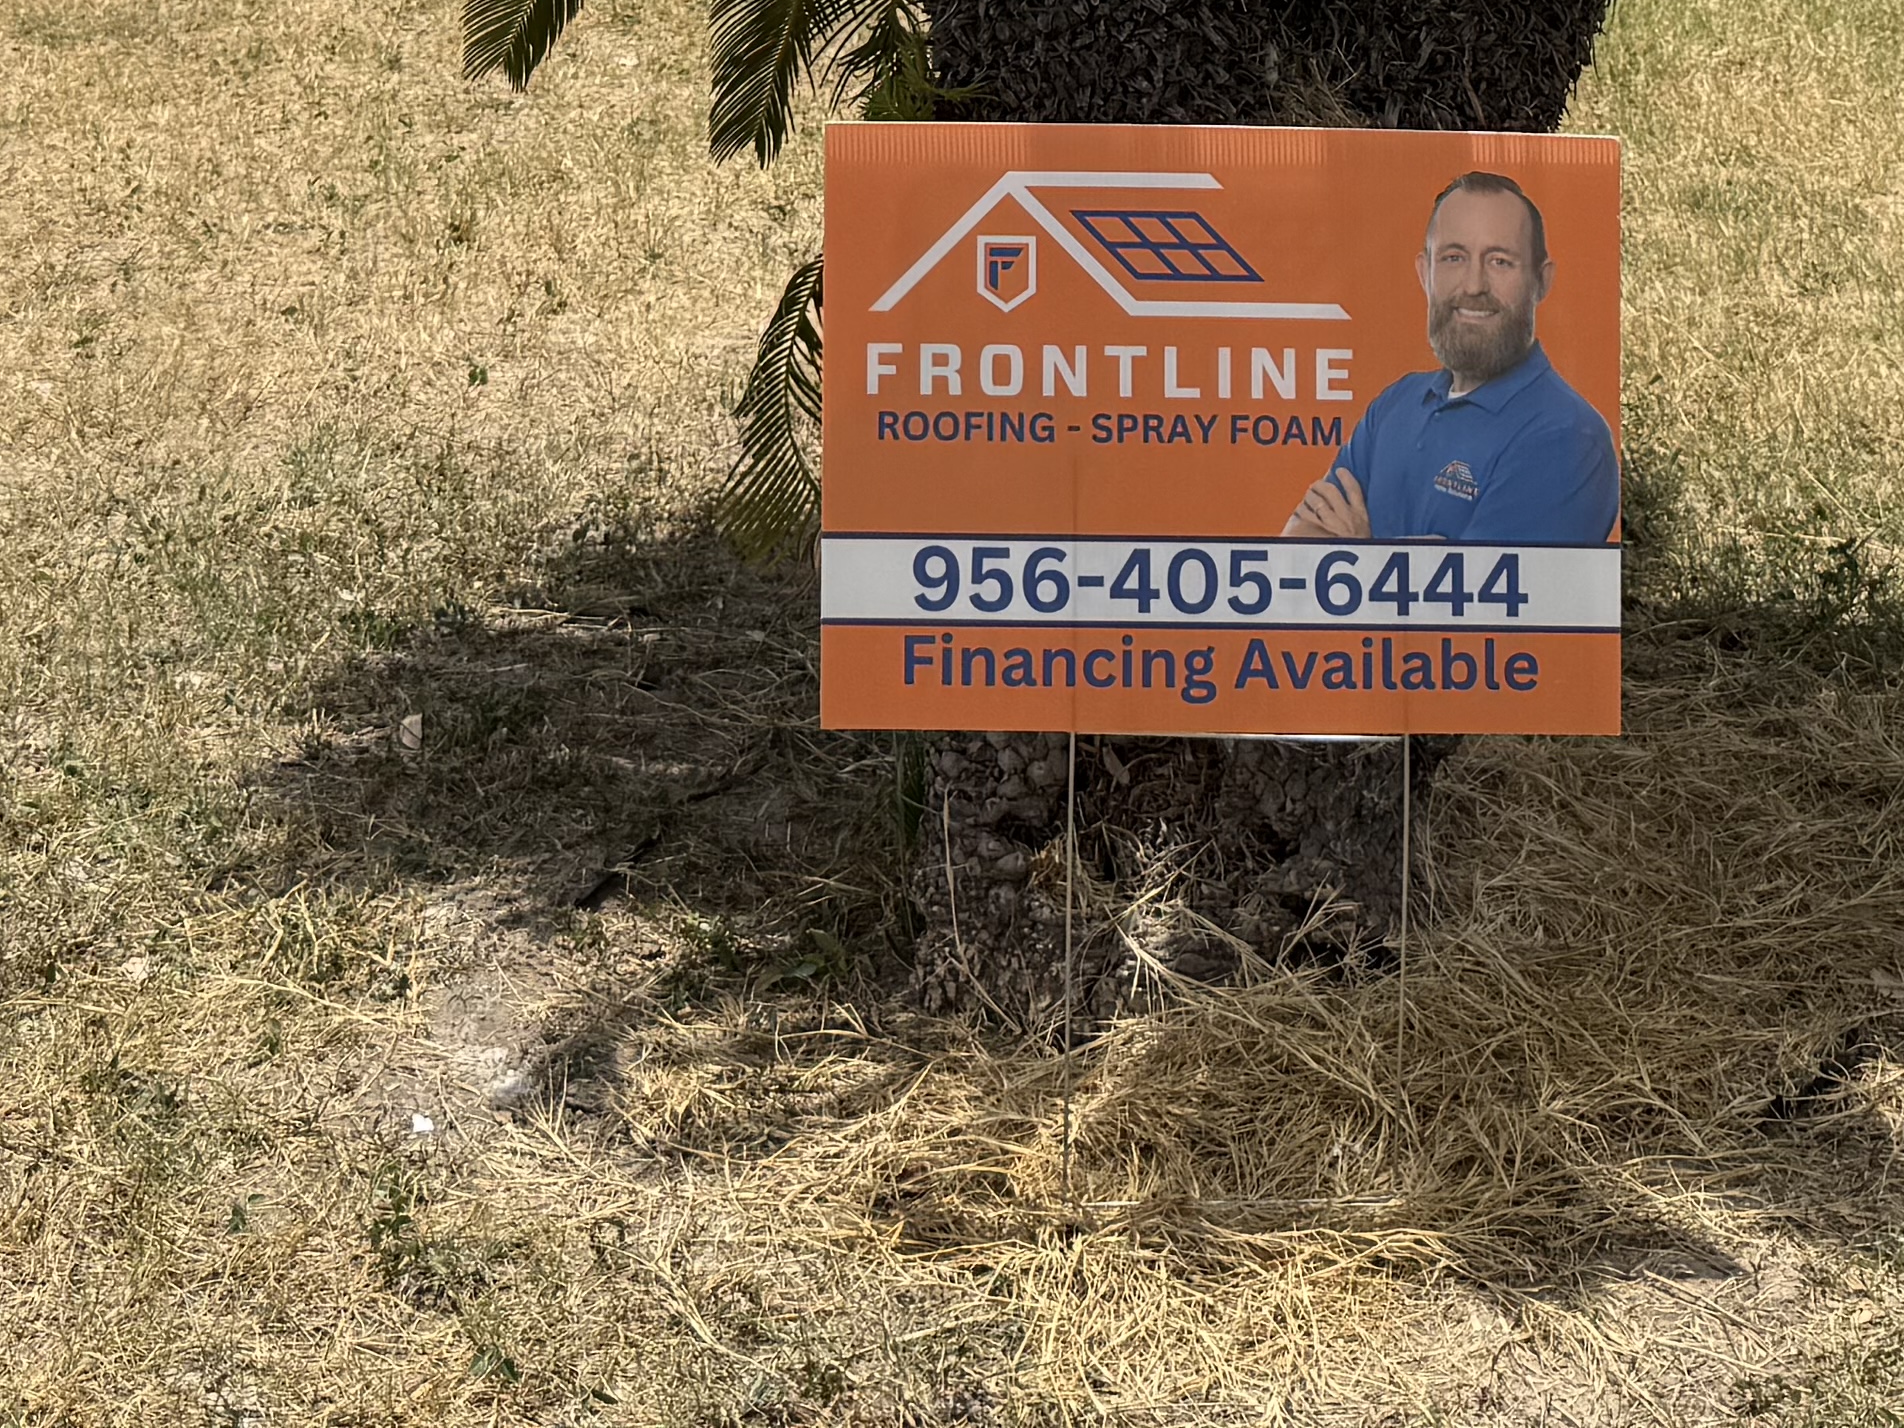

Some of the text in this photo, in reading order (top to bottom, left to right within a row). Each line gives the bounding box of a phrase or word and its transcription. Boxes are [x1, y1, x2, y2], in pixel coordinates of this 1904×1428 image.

[866, 342, 1354, 401] FRONTLINE
[877, 410, 1056, 443] ROOFING
[1092, 412, 1219, 445] SPRAY
[1230, 414, 1342, 446] FOAM
[912, 544, 1529, 618] 956-405-6444
[903, 632, 1540, 704] Financing Available
